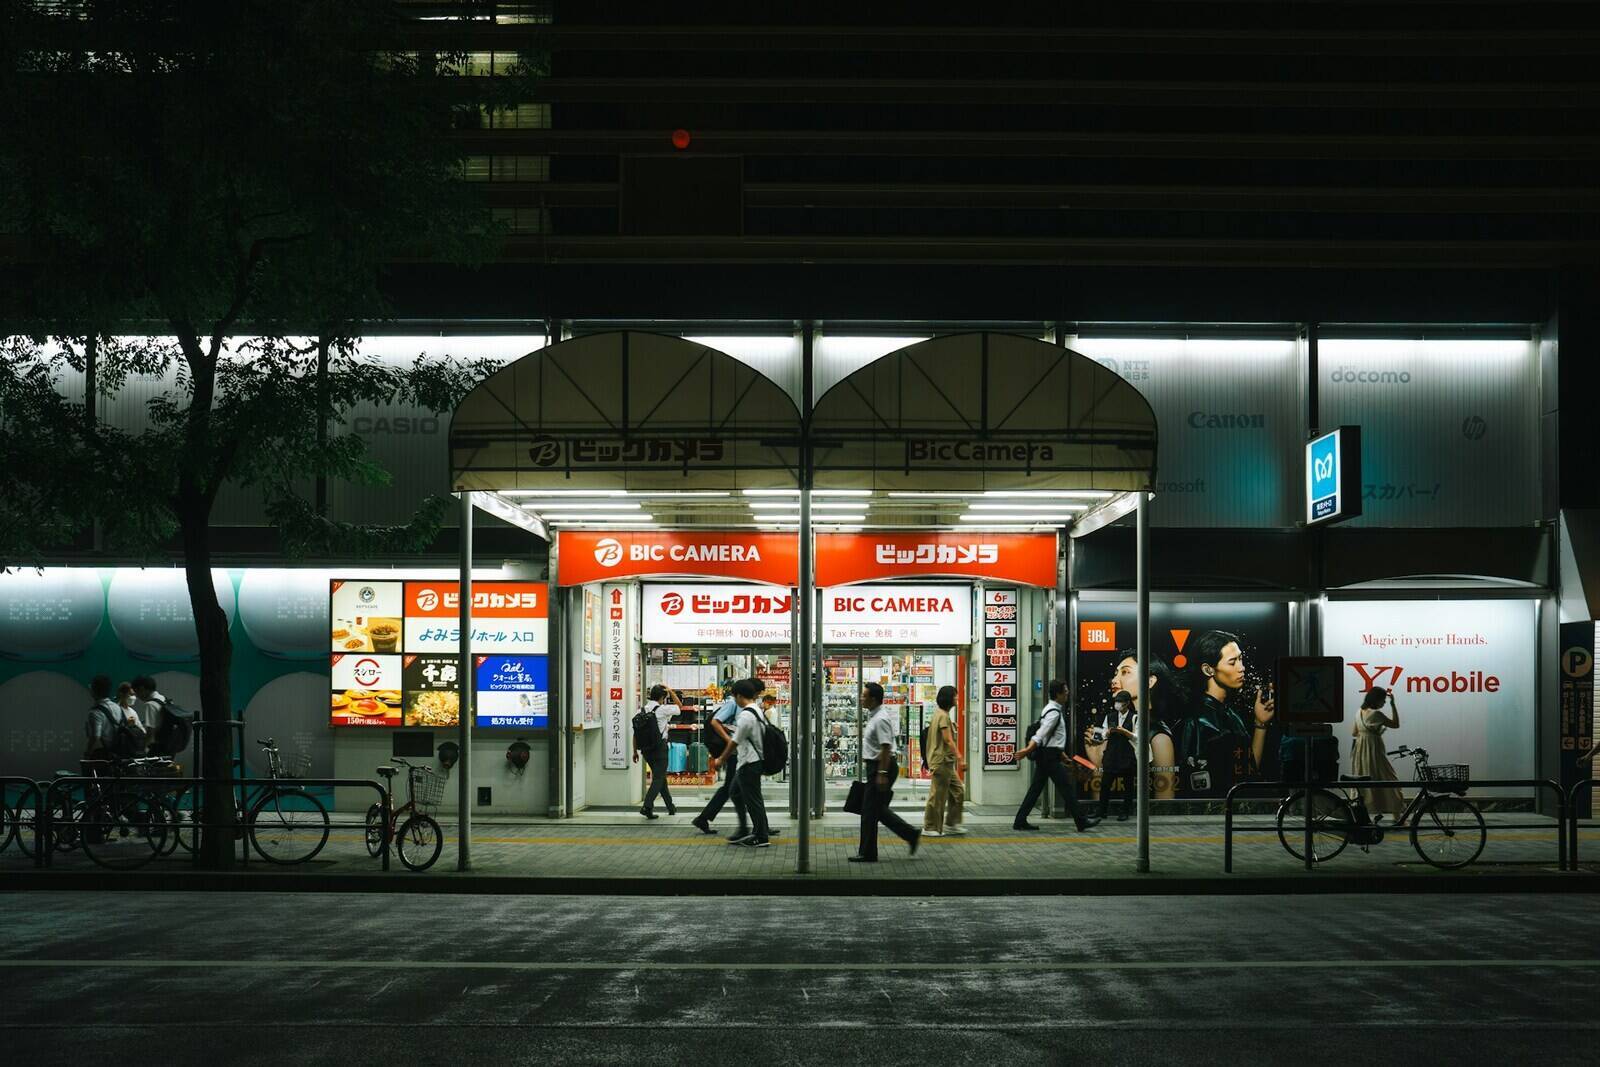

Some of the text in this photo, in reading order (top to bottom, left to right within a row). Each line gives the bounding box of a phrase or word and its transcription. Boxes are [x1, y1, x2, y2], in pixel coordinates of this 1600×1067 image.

[1123, 360, 1149, 370] NTT
[1331, 366, 1411, 384] docomo
[354, 417, 440, 435] CASIO
[1188, 411, 1265, 429] Canon
[573, 439, 724, 462] ビックカメラ
[909, 440, 1054, 461] BicCamera
[1156, 478, 1206, 493] crosoft
[630, 545, 664, 561] BIC
[670, 545, 760, 562] CAMERA
[875, 544, 998, 564] ビックカメラ
[443, 592, 537, 608] ビクカメラ
[994, 592, 1008, 602] 6F
[692, 595, 799, 614] ビックカメ
[833, 597, 954, 612] BIC CAMERA
[511, 631, 534, 642] 入口
[830, 630, 847, 638] Tax
[850, 630, 870, 638] Free
[994, 625, 1008, 636] 3F
[1088, 629, 1110, 643] JBL
[1362, 634, 1488, 648] Magic in your Hands.
[612, 621, 621, 682] 角川シネマ有楽町
[994, 671, 1008, 682] 2F
[991, 686, 1011, 697] お酒
[991, 703, 1010, 713] B1F
[491, 717, 533, 725] 処方せん受付
[612, 701, 621, 754] よみうりホール
[986, 717, 1016, 725] リフォーム
[991, 731, 1011, 742] B2F
[988, 744, 1014, 753] 自転車
[988, 753, 1013, 763] ゴルフ
